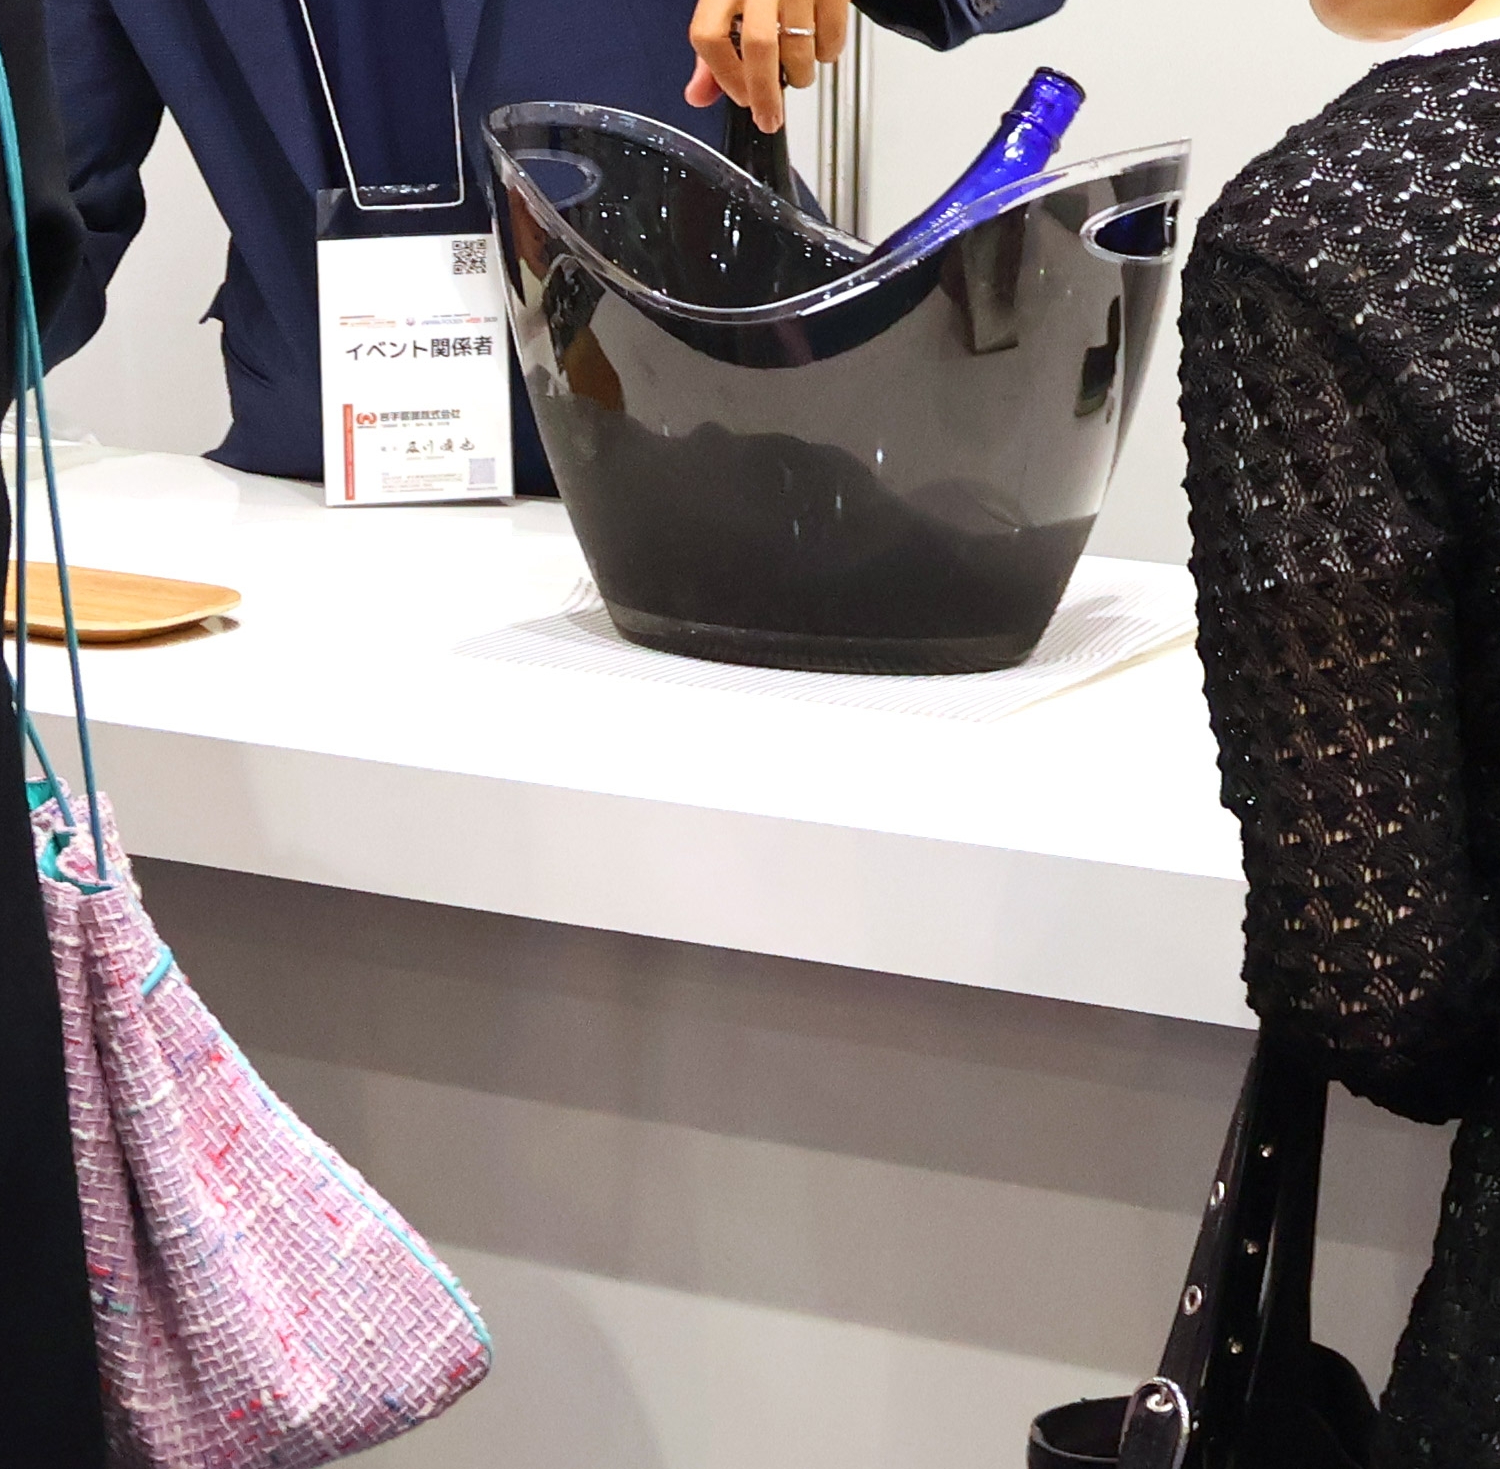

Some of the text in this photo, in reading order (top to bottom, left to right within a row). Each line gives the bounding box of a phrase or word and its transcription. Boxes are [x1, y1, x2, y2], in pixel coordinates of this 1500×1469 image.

[346, 335, 493, 361] イベント関係者
